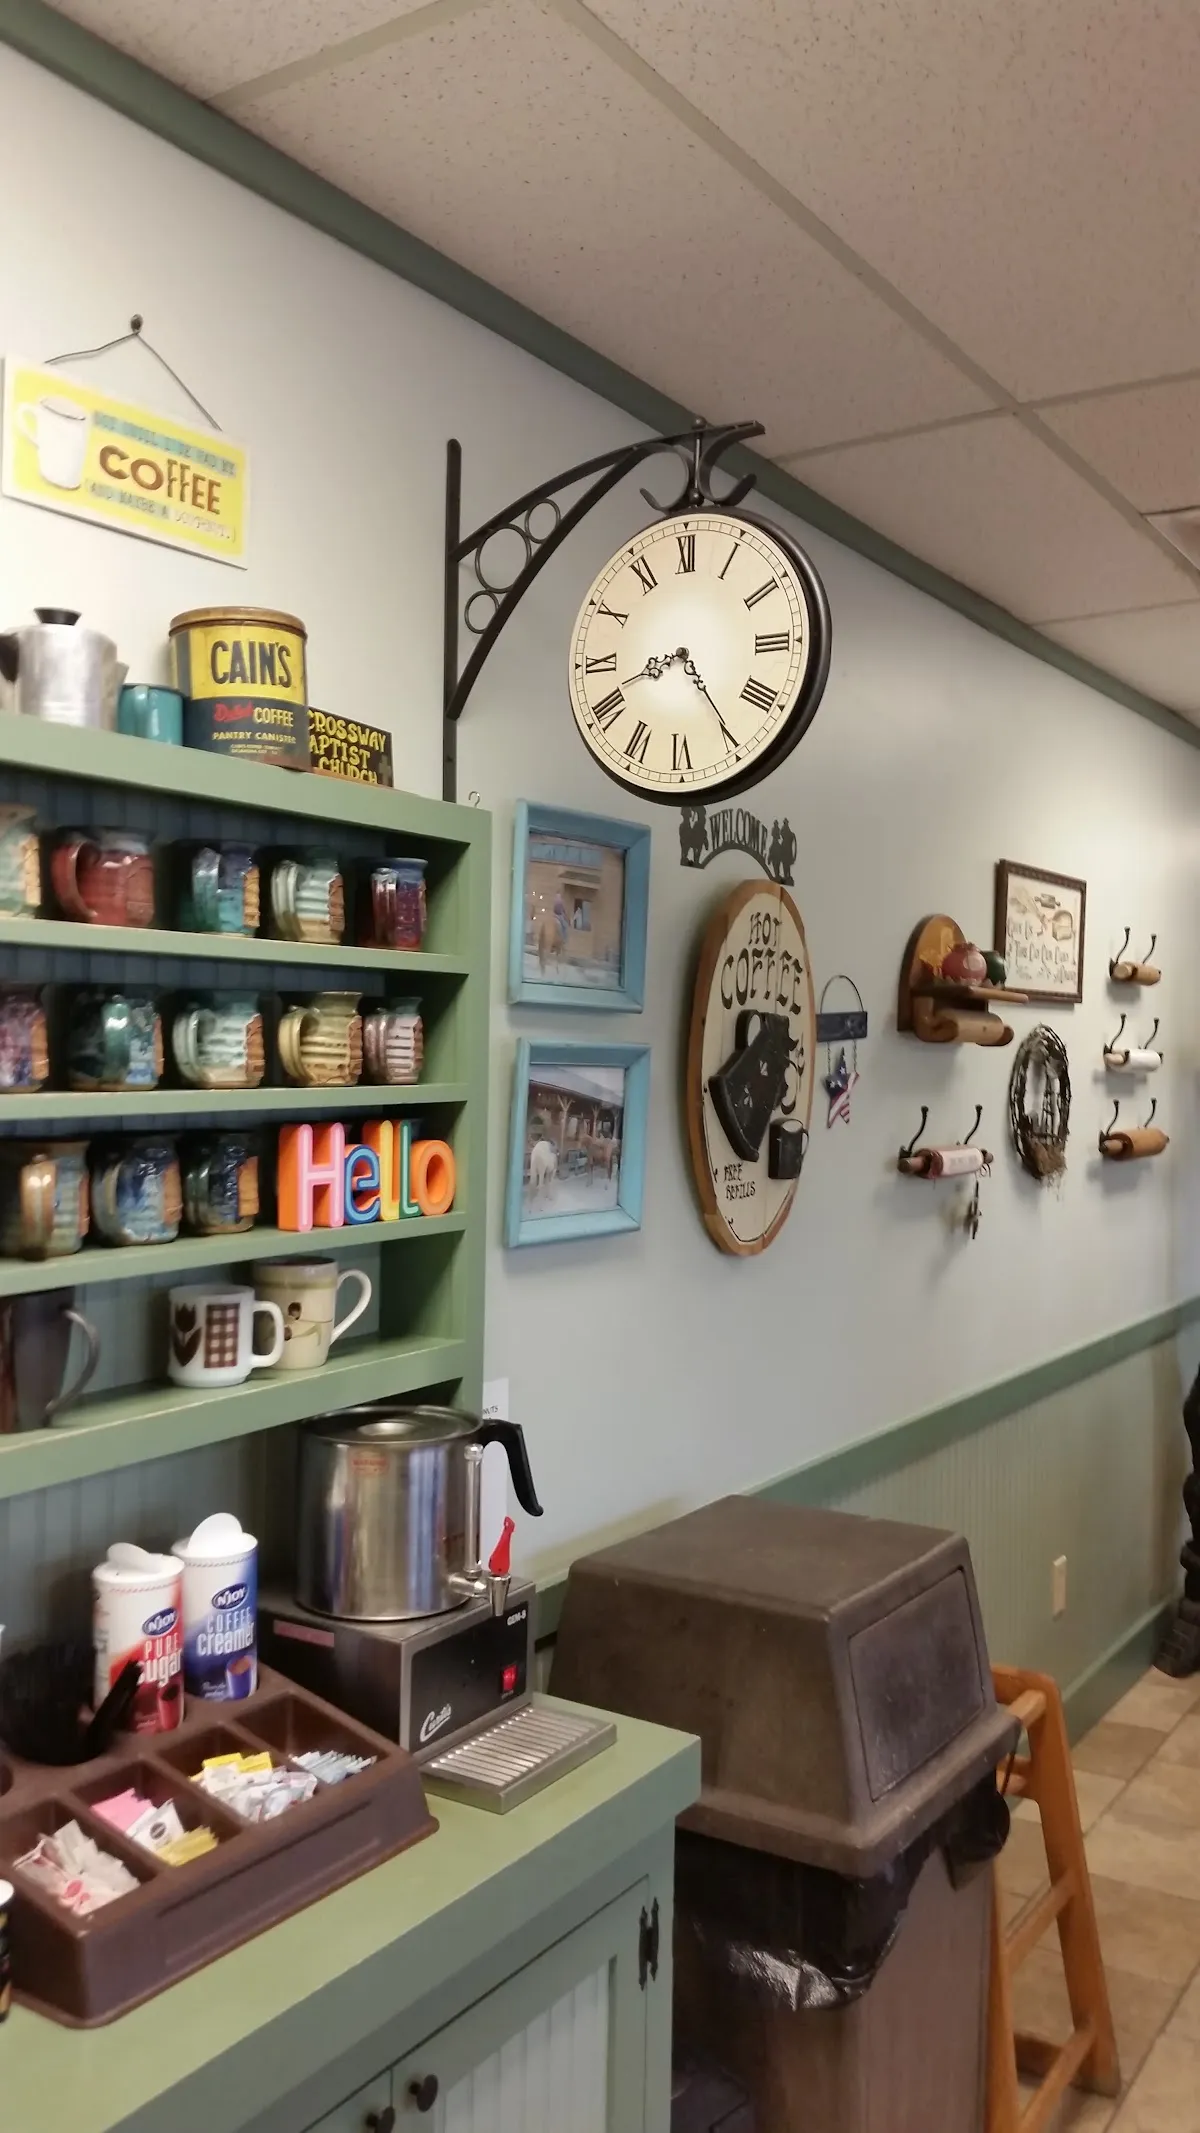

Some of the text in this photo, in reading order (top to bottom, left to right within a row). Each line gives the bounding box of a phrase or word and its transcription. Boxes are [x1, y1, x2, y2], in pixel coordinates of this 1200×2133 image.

[99, 445, 221, 515] COFFEE
[674, 534, 696, 575] XII
[628, 555, 658, 596] XI
[596, 599, 629, 628] X
[754, 630, 790, 655] III
[210, 640, 293, 689] CAIN'S
[253, 706, 294, 728] COFFEE
[306, 709, 387, 753] CROSSWAY
[211, 731, 297, 745] PANTRY CANISTER
[308, 734, 371, 770] APTIST
[709, 808, 768, 860] WELCOME
[748, 911, 782, 947] HOT
[720, 947, 803, 1016] COFFEE
[723, 1162, 743, 1182] FREE
[725, 1181, 756, 1201] REFILLS
[207, 1606, 252, 1634] COFFEE
[145, 1632, 180, 1659] PURE
[197, 1621, 255, 1657] creamer
